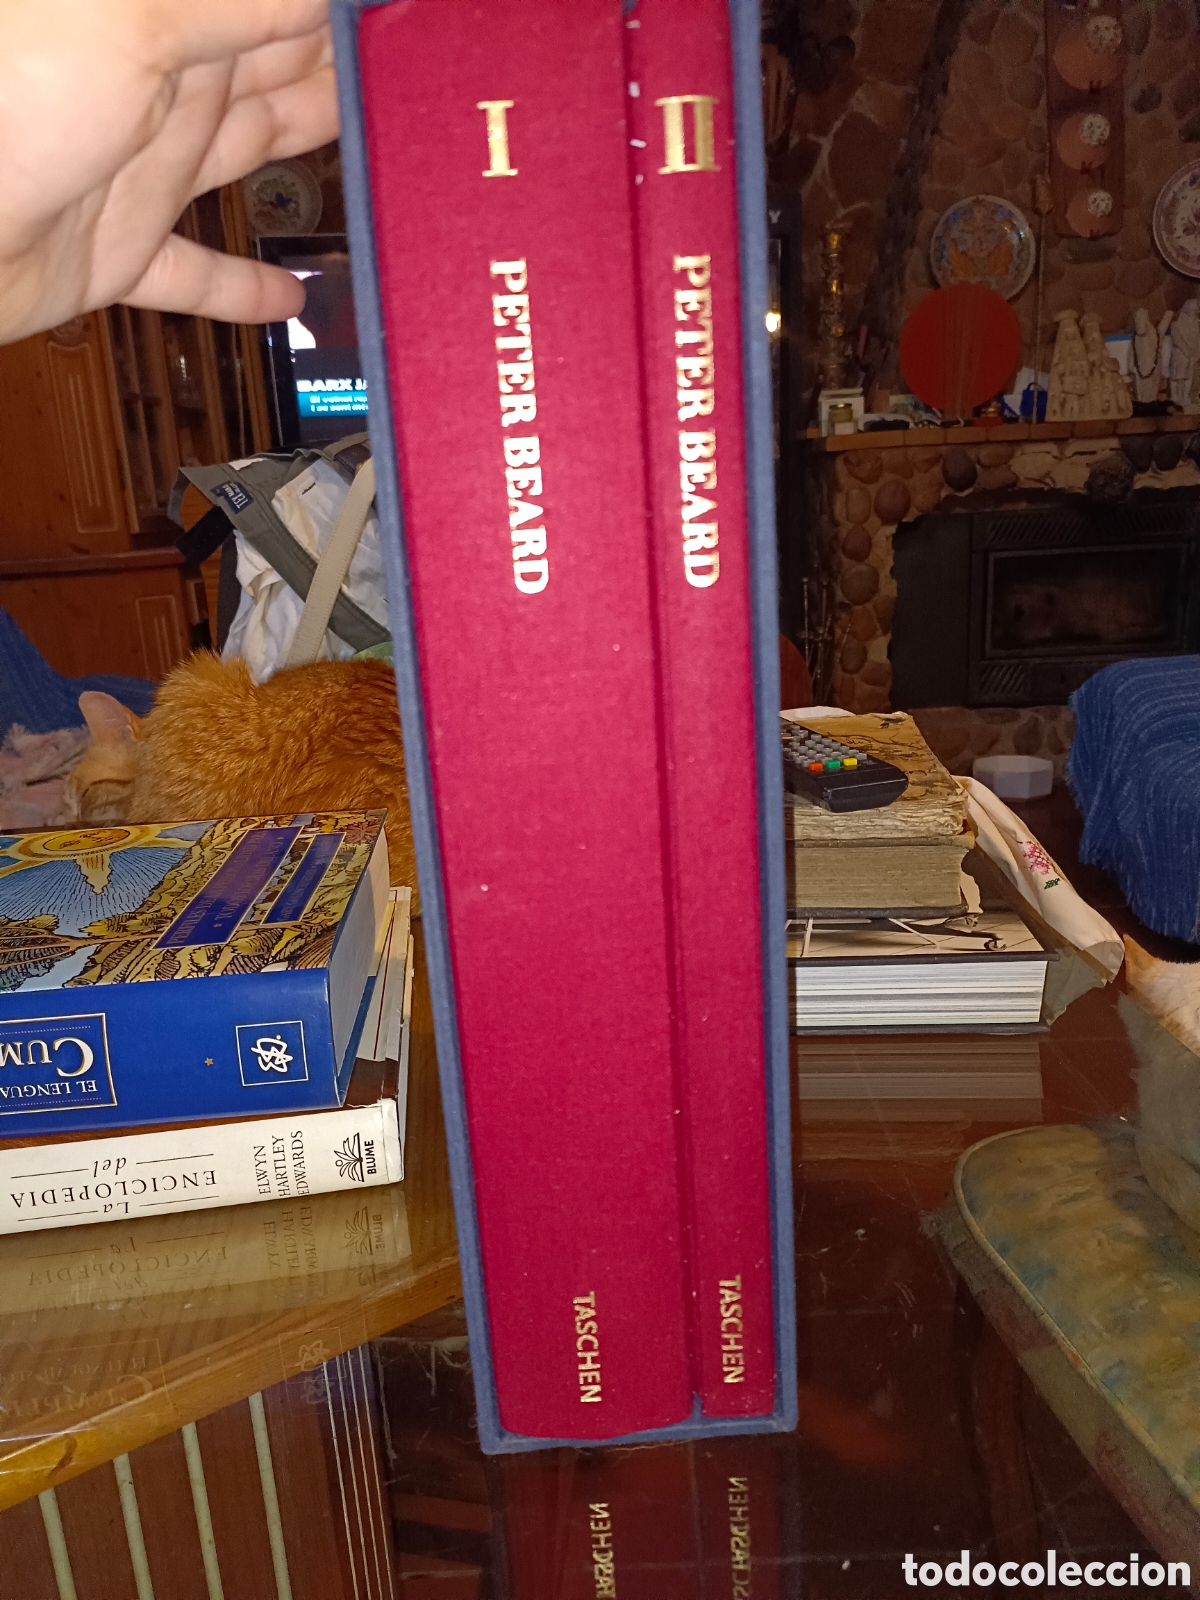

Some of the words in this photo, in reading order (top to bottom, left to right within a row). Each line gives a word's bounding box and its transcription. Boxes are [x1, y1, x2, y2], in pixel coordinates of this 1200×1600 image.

[477, 99, 519, 178] I
[655, 94, 721, 175] II
[490, 258, 538, 428] PETER
[673, 254, 715, 422] PETER
[231, 492, 249, 509] TEX
[503, 433, 550, 595] BEARD
[677, 429, 720, 589] BEARD
[76, 1080, 98, 1093] EL
[10, 1170, 218, 1209] ENCICLOPEDIA
[93, 1157, 127, 1178] del
[253, 1145, 271, 1195] ELWYN
[271, 1135, 291, 1197] HARTLEY
[291, 1130, 310, 1196] EDWARDS
[364, 1139, 377, 1175] BLUME
[103, 1202, 130, 1214] La
[572, 1290, 602, 1403] TASCHEN
[718, 1275, 745, 1384] TASCHEN
